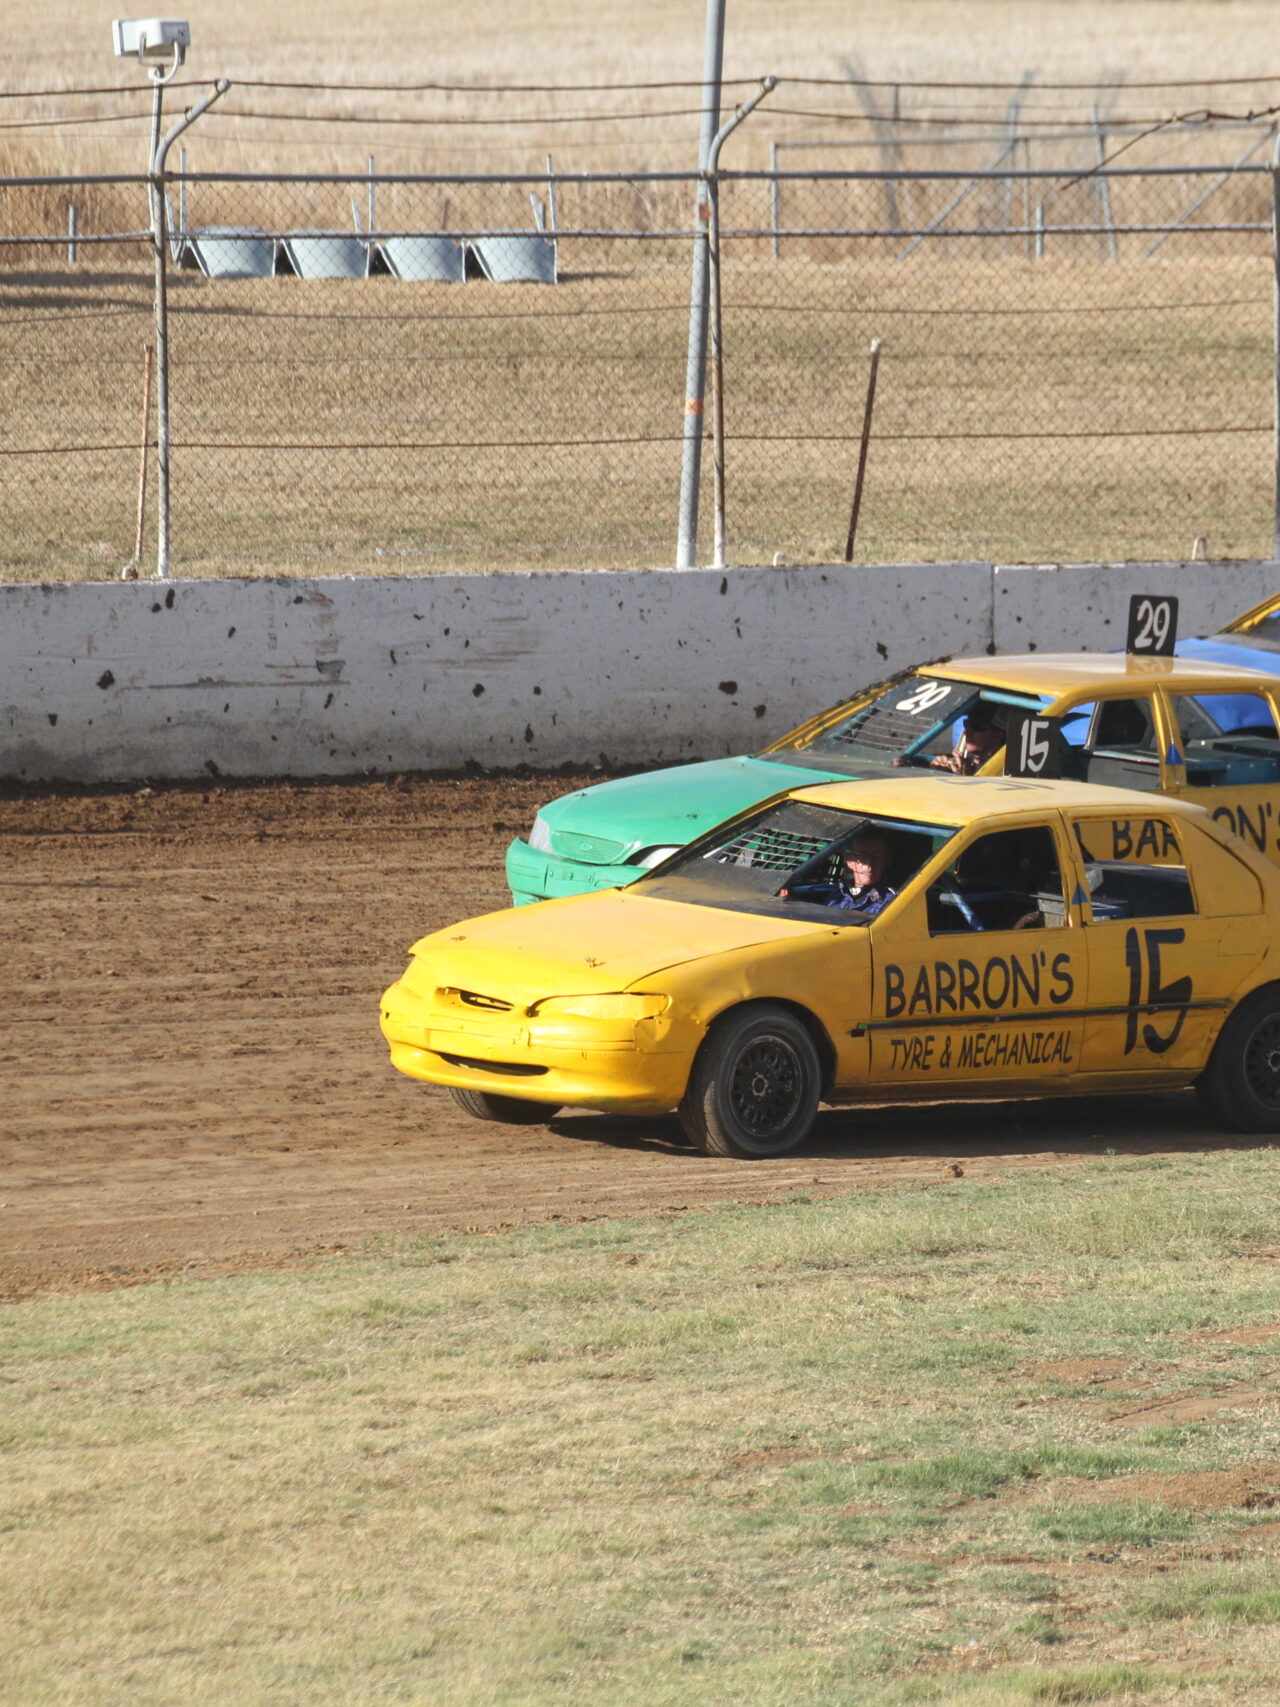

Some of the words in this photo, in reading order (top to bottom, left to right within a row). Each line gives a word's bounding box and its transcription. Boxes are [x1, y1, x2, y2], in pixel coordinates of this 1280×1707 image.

[1133, 600, 1170, 651] 29
[895, 681, 952, 715] 29
[1020, 719, 1049, 773] 15
[884, 951, 1074, 1018] BARRON'S
[1124, 927, 1193, 1056] 15
[890, 1034, 935, 1071] TYRE
[939, 1034, 952, 1069] &
[957, 1031, 1073, 1069] MECHANICAL
